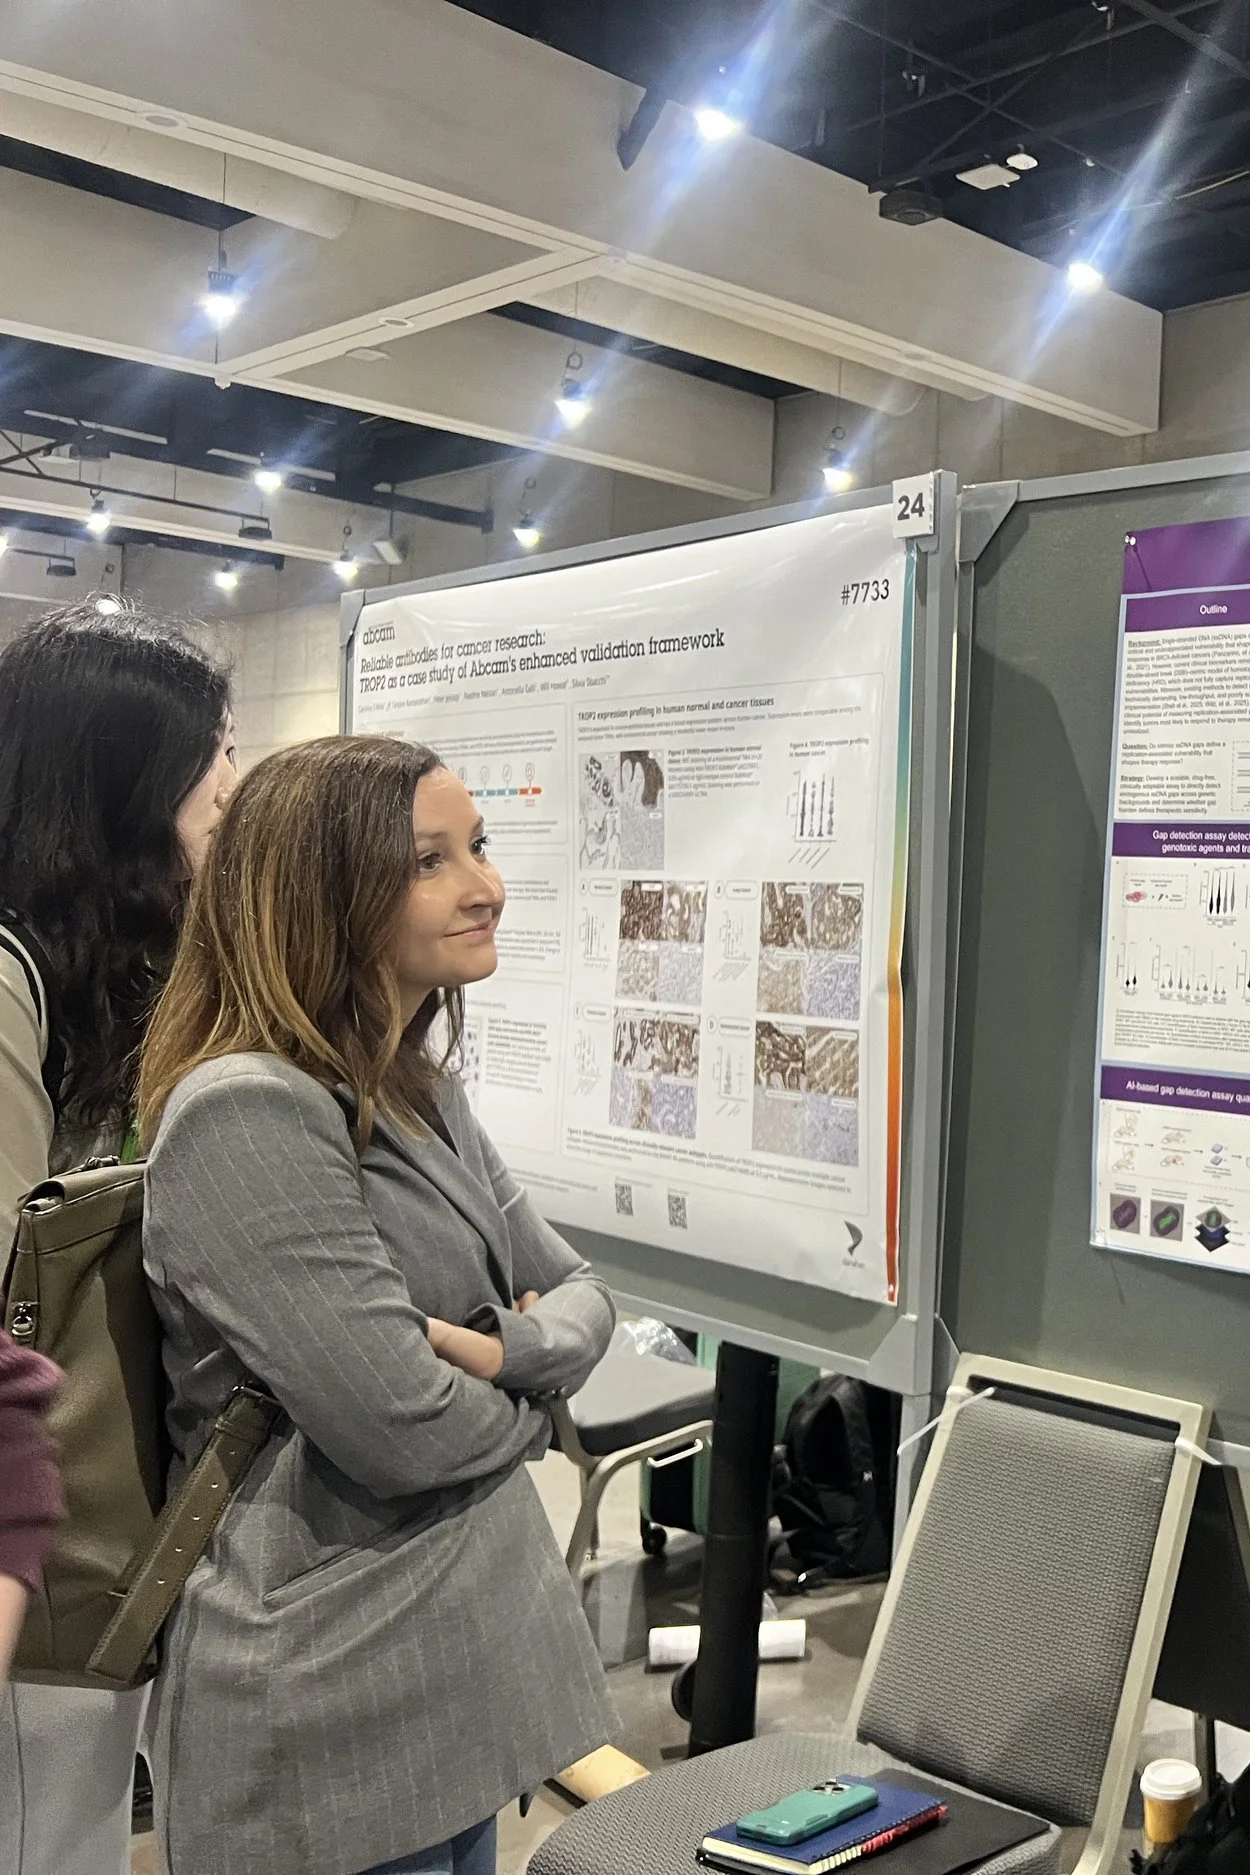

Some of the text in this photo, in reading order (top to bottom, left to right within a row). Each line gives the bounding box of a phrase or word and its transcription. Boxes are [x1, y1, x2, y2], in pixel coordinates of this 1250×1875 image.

[897, 492, 924, 520] 24
[841, 579, 890, 605] #7733
[1199, 605, 1228, 615] Outline
[363, 624, 395, 645] abcam
[359, 627, 725, 692] TROP2 as a case study of Abcam's enhanced validation framework
[360, 628, 546, 674] Reliable antibodies for cancer research:
[596, 709, 628, 721] expression
[655, 706, 662, 714] in
[662, 705, 685, 714] human
[686, 701, 710, 712] normal
[711, 700, 725, 710] and
[725, 701, 749, 709] cancer
[749, 698, 774, 707] tissues
[1152, 830, 1168, 841] Gap
[1169, 830, 1203, 840] detection
[1204, 833, 1226, 842] assay
[1162, 843, 1196, 853] genotoxic
[1198, 843, 1223, 854] agents
[1225, 843, 1240, 852] and
[1126, 1079, 1159, 1092] AI-based
[1160, 1085, 1175, 1097] gap
[1175, 1085, 1210, 1098] detection
[1211, 1091, 1234, 1103] assay
